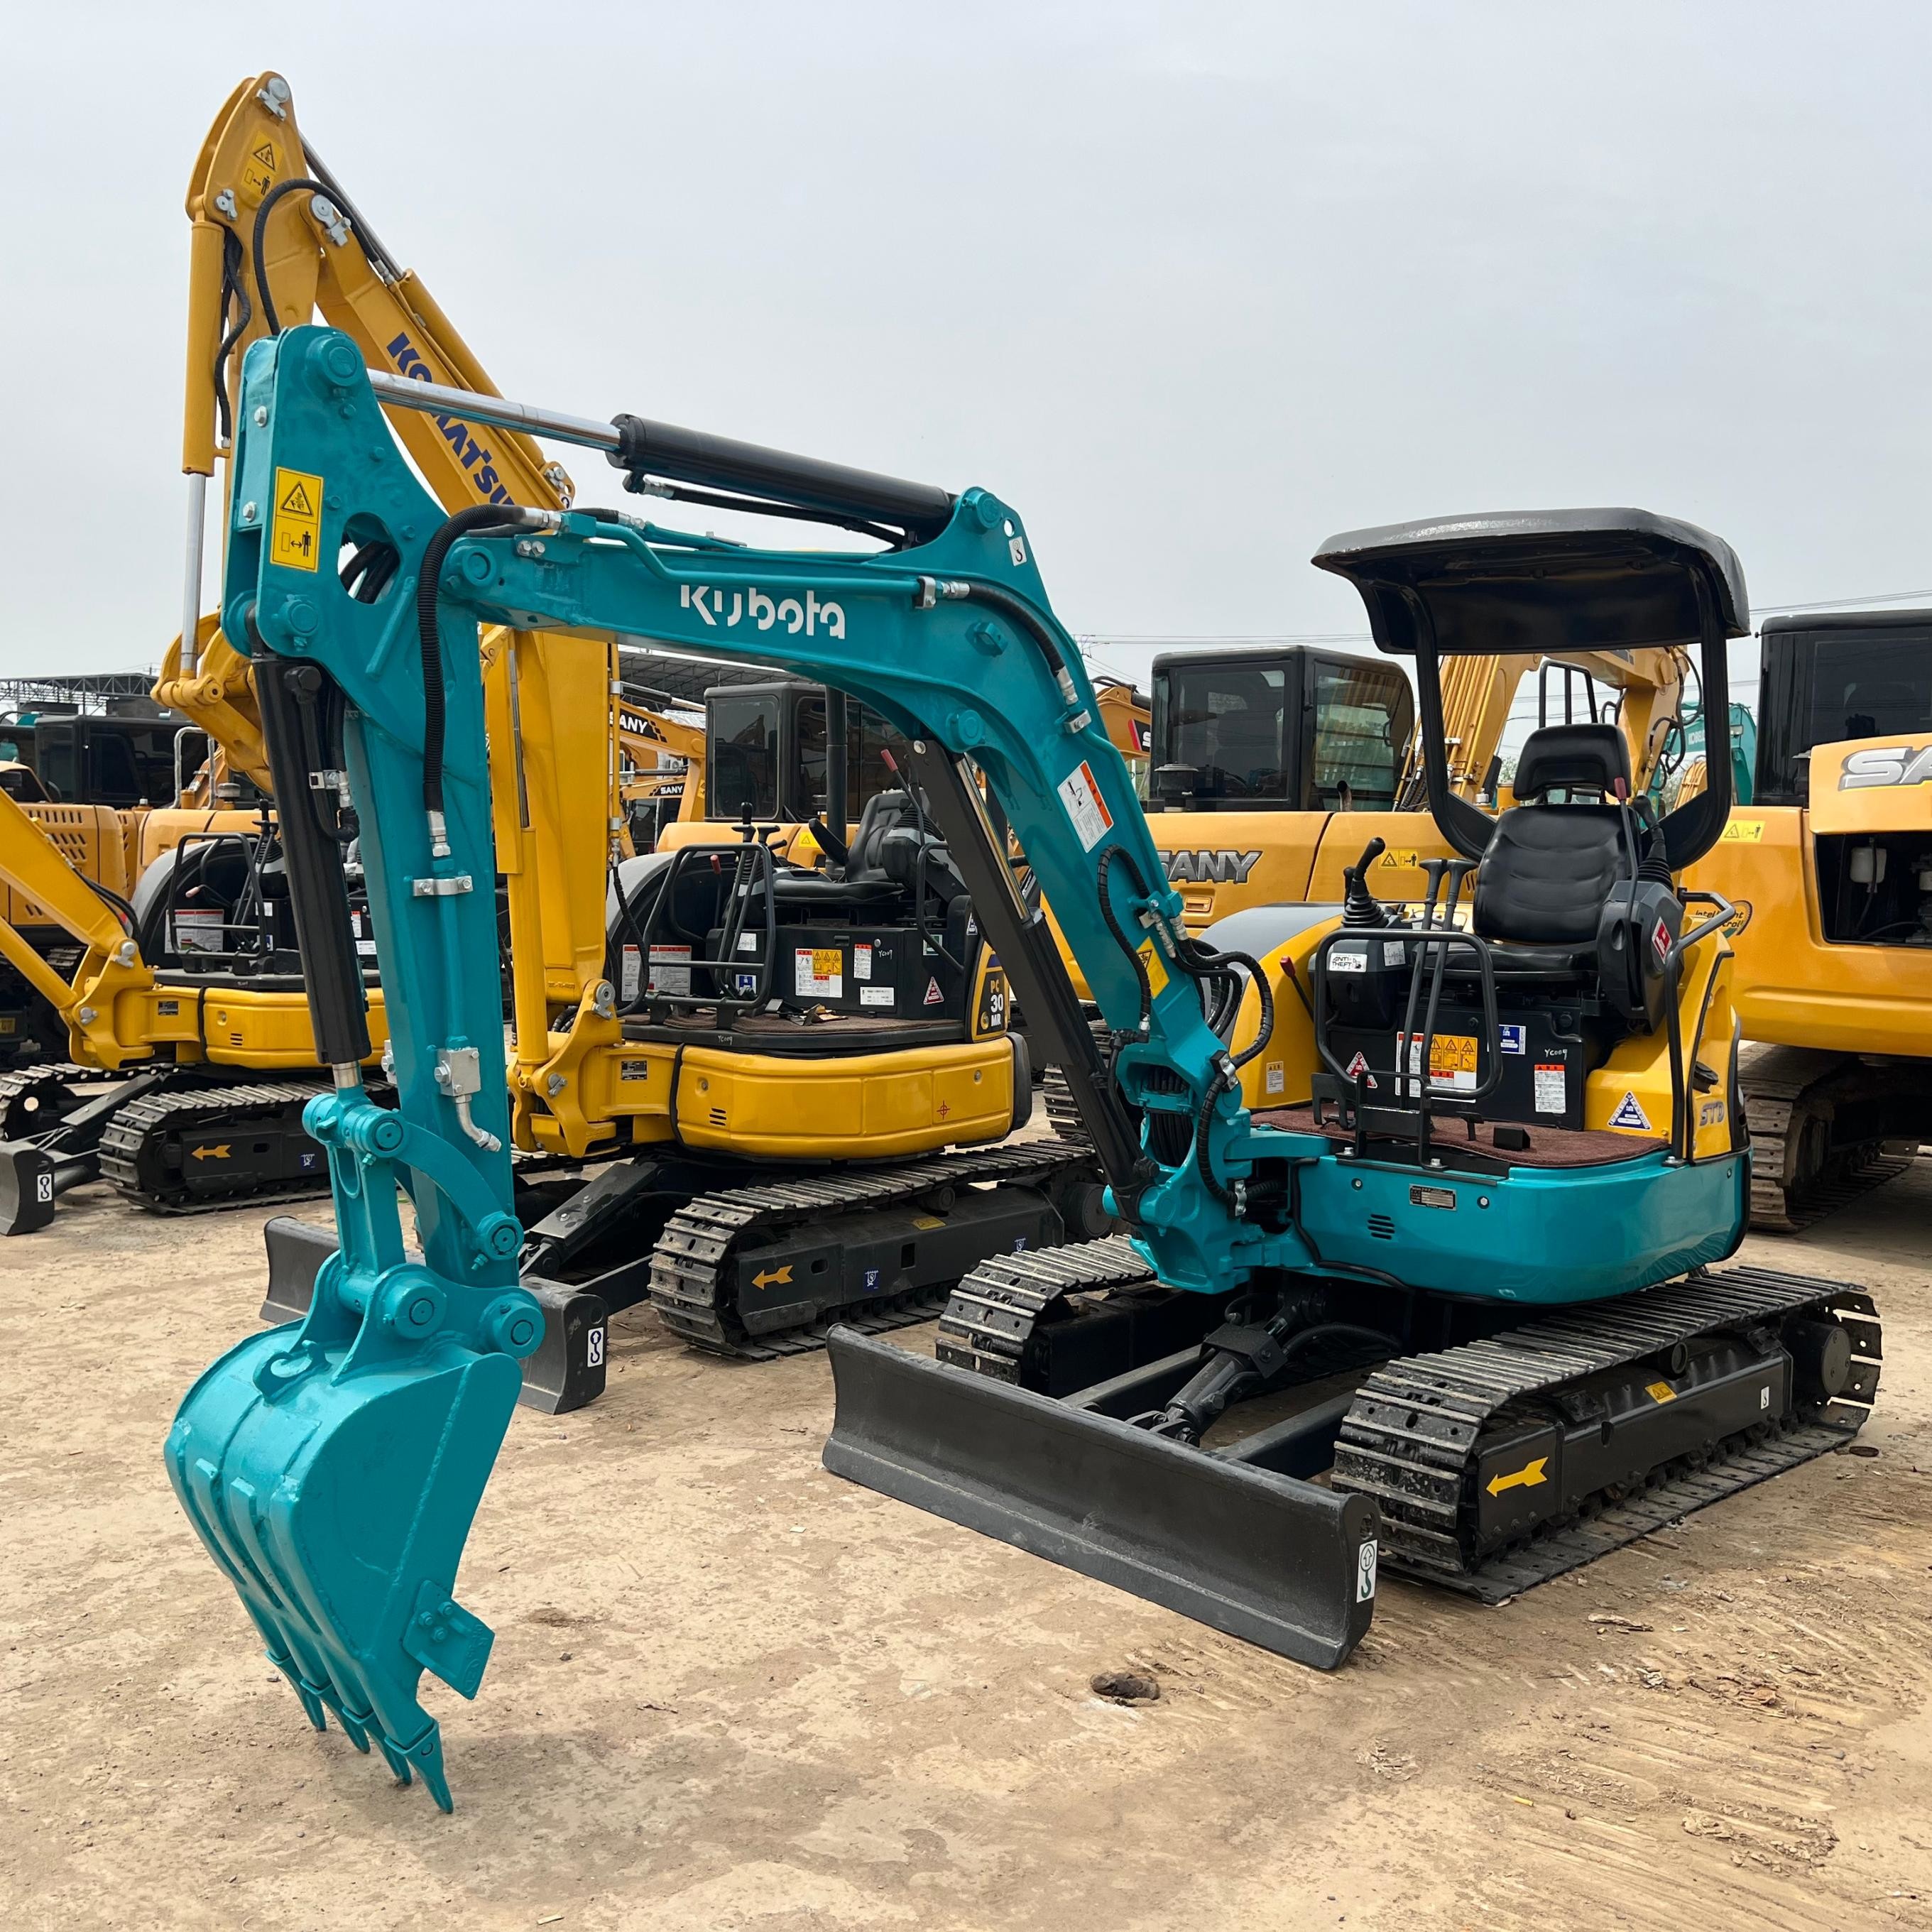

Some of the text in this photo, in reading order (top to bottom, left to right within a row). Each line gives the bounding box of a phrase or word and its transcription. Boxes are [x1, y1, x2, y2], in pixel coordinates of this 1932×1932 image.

[680, 584, 846, 640] Kubota
[660, 785, 683, 795] SANY
[990, 978, 1000, 993] PC
[990, 993, 1003, 1013] 30
[990, 1013, 1001, 1027] MR
[1699, 1101, 1725, 1126] STD
